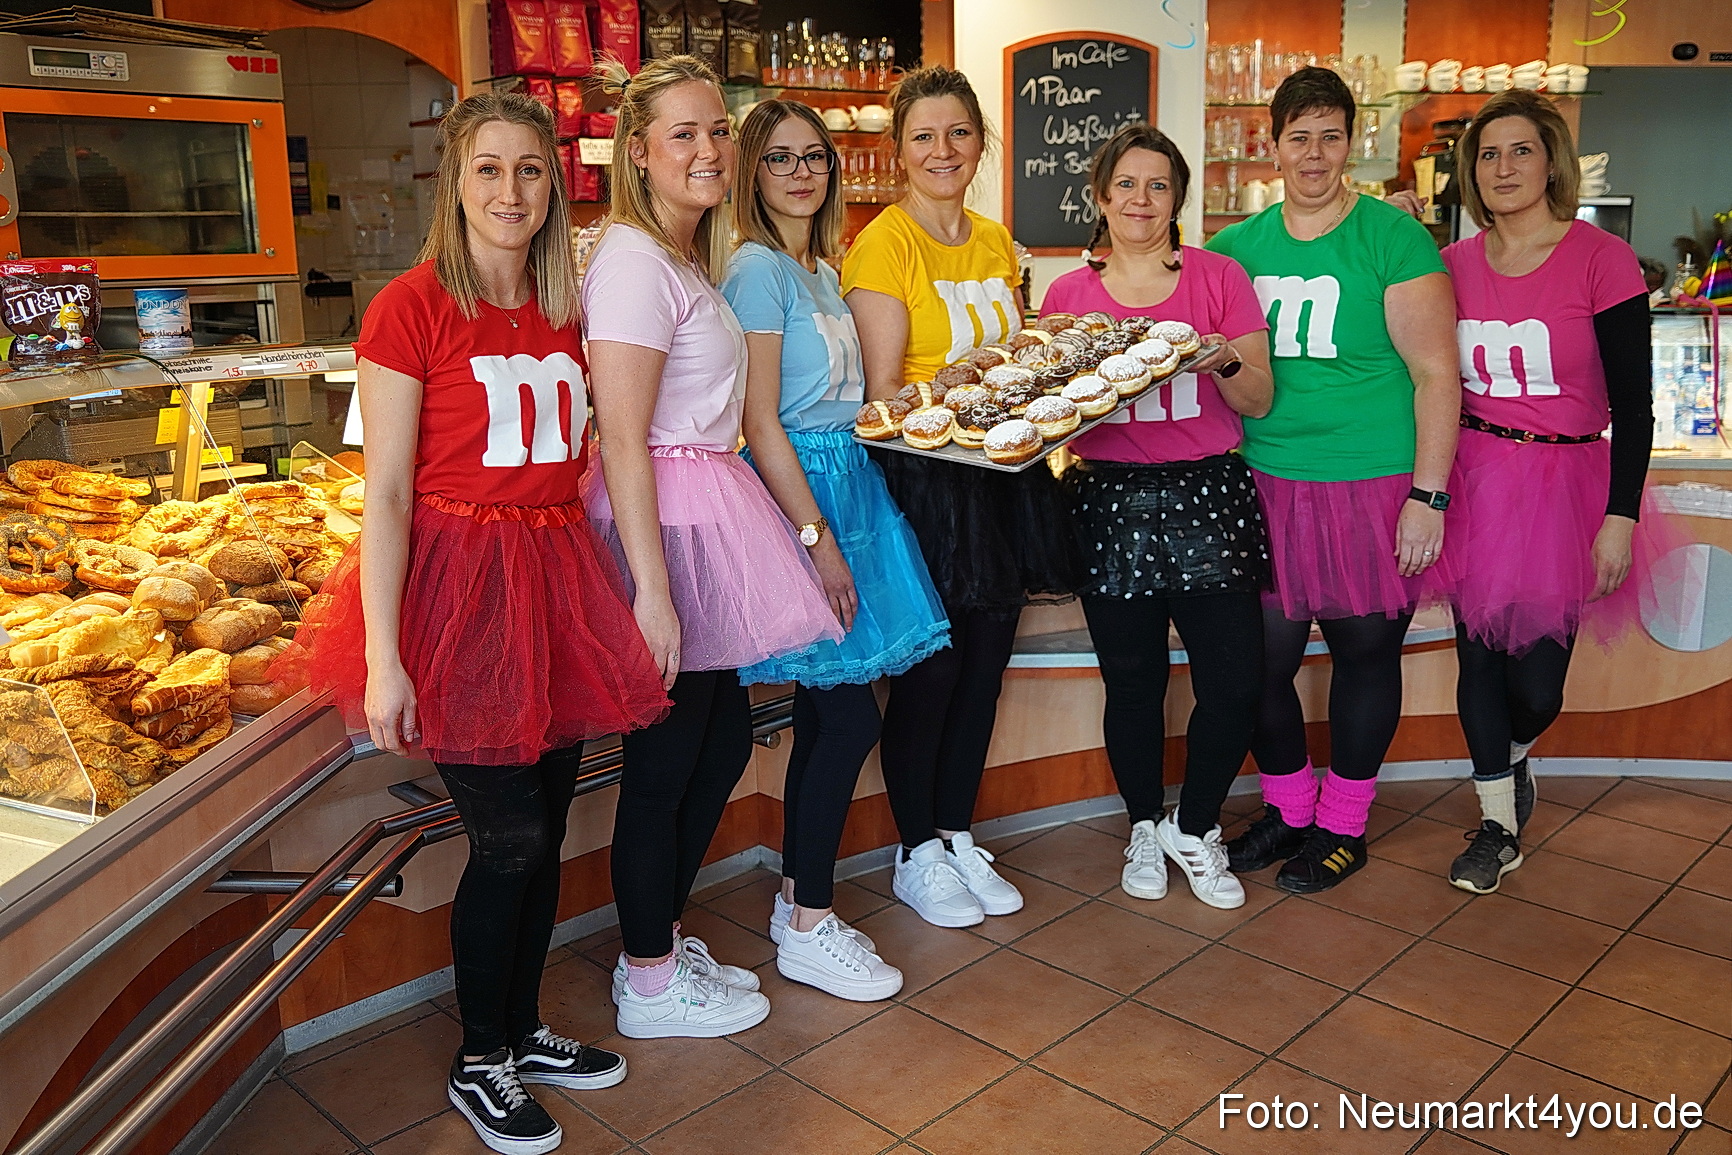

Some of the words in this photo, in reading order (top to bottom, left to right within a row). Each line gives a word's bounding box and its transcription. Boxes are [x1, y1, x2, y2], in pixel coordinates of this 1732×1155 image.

[1052, 46, 1078, 70] Im
[1019, 77, 1037, 106] 1
[1038, 75, 1102, 107] Paar
[1025, 151, 1059, 178] mit
[296, 360, 319, 372] 1,70
[469, 351, 588, 467] m
